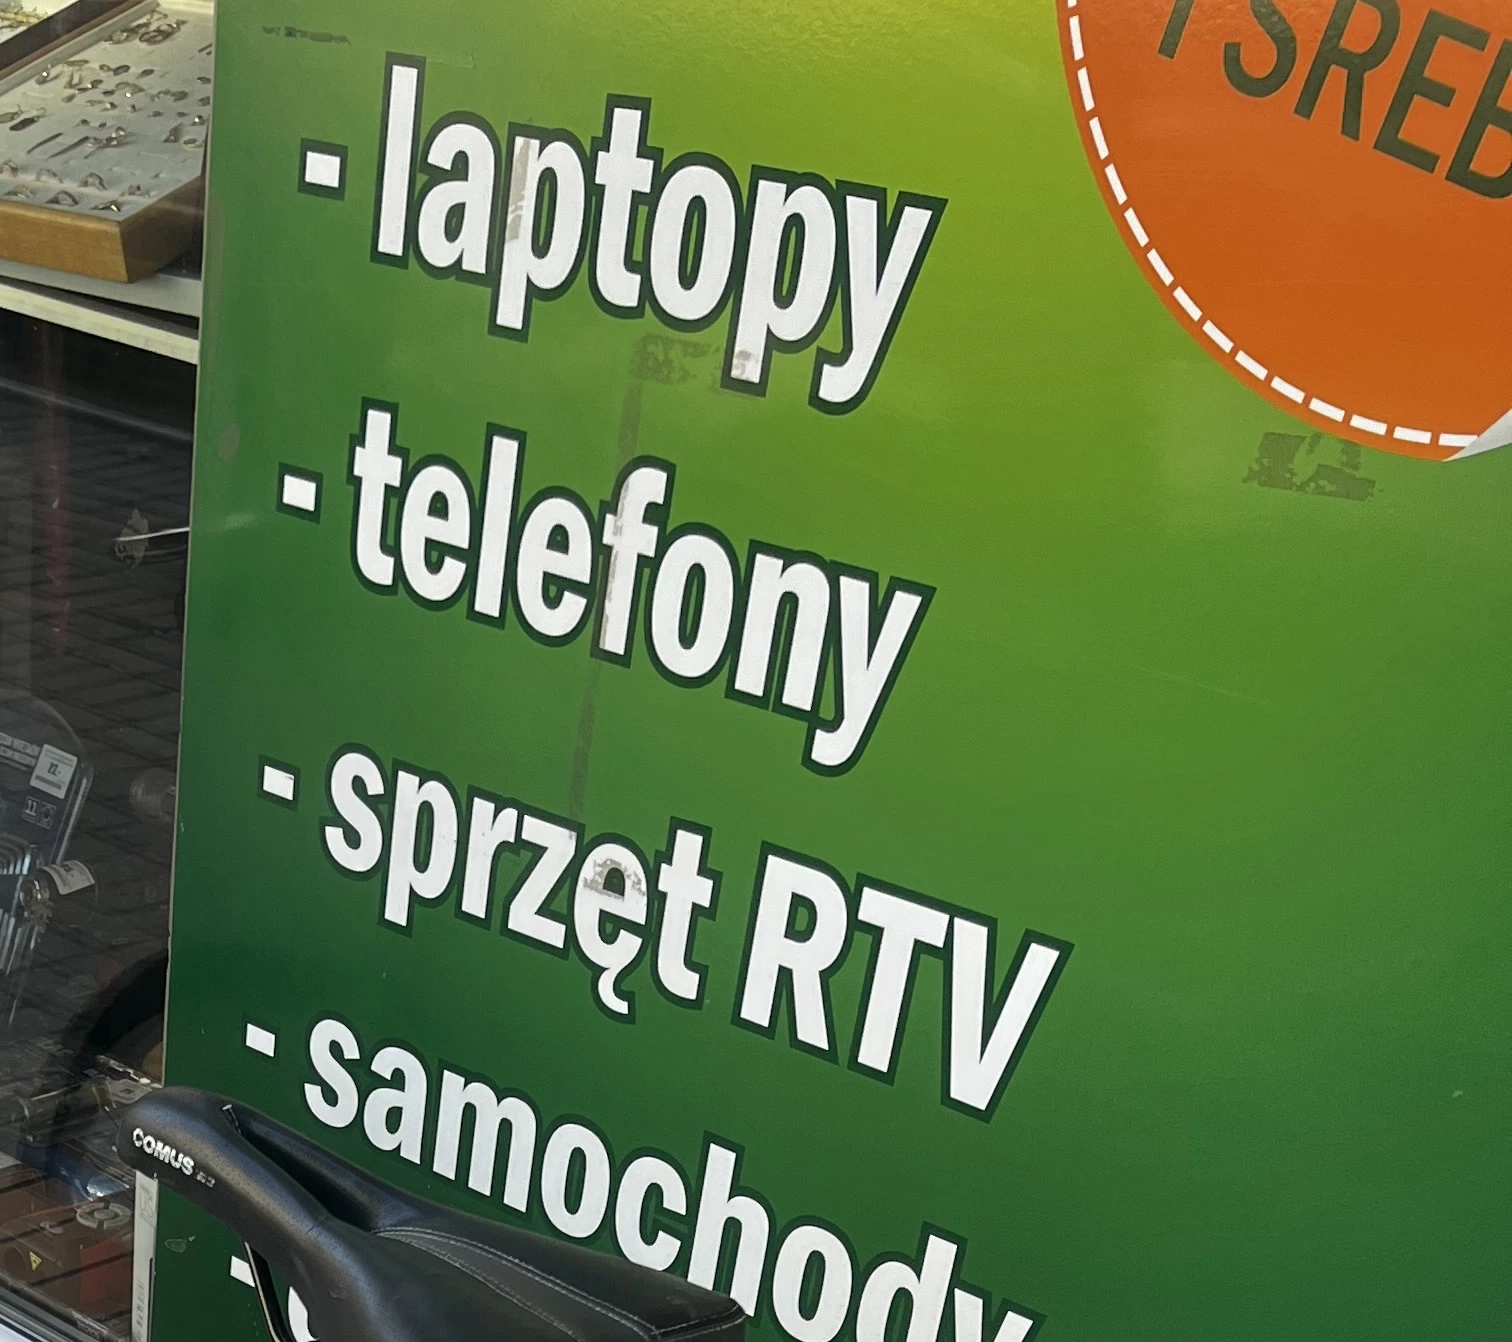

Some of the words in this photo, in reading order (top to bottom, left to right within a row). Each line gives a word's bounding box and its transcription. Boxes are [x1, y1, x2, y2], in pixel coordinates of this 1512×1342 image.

[377, 64, 934, 404] laptopy
[353, 409, 923, 767] telefony
[324, 752, 715, 1016] sprzęt
[739, 854, 1061, 1112] RTV
[133, 1128, 195, 1176] COMUS
